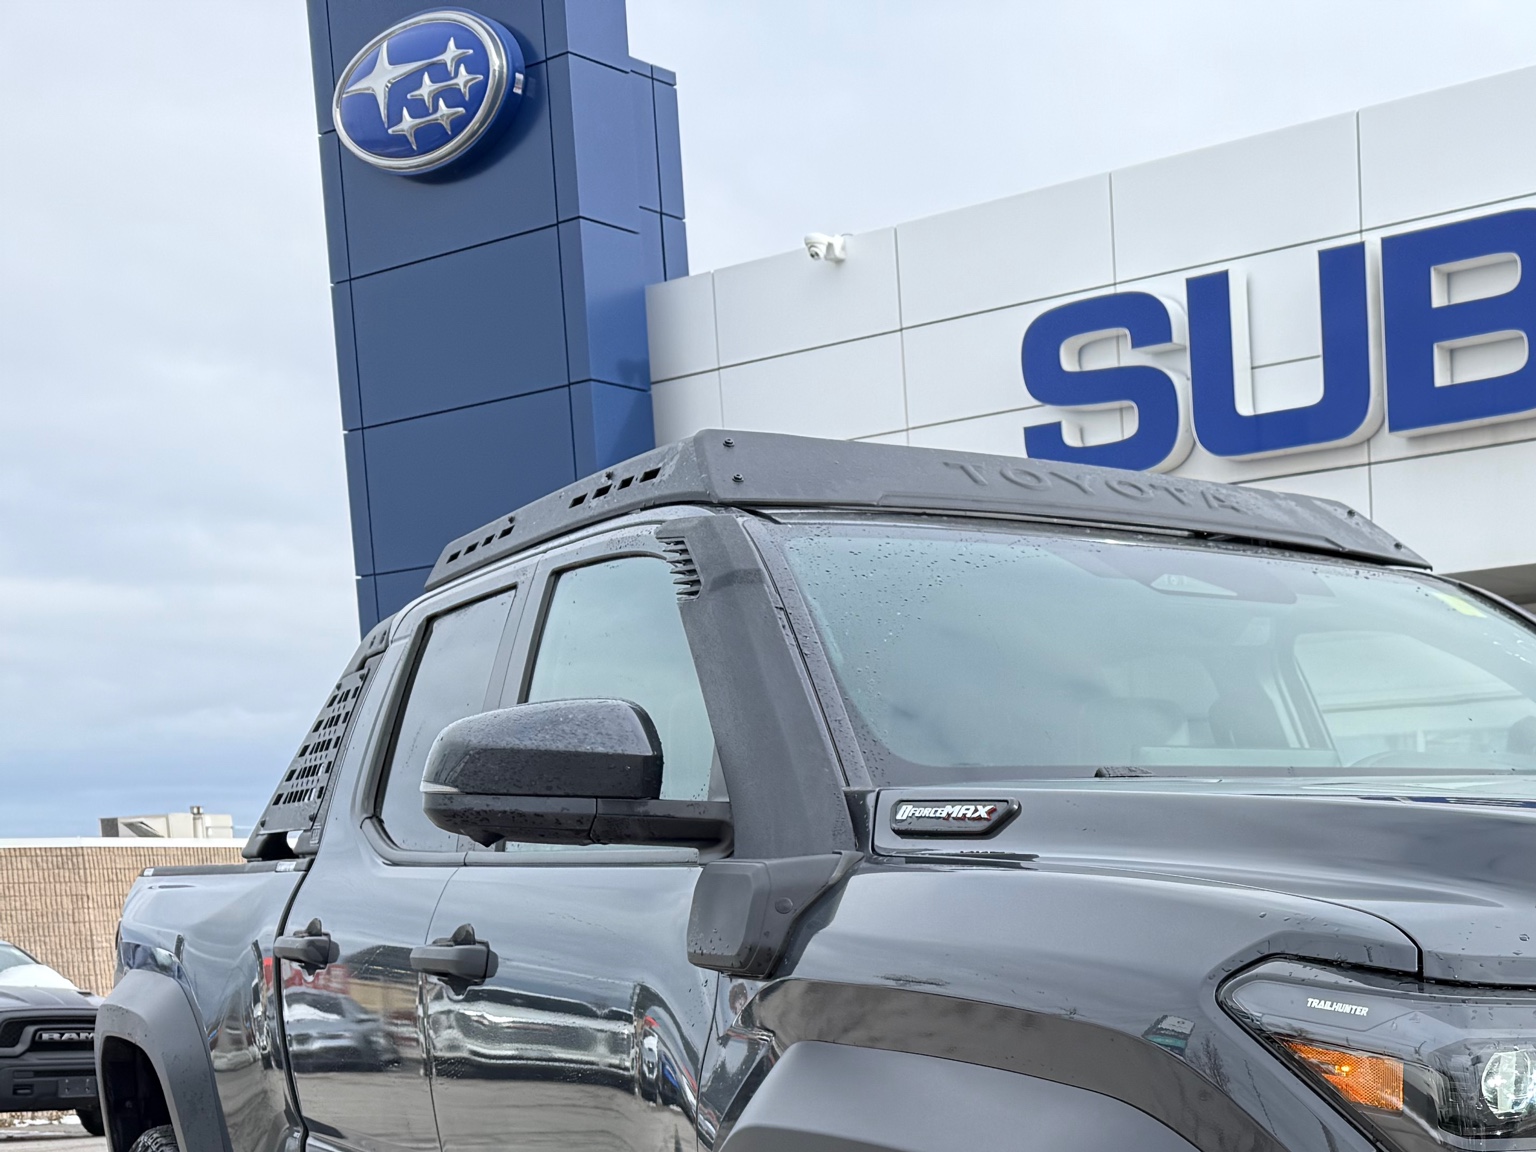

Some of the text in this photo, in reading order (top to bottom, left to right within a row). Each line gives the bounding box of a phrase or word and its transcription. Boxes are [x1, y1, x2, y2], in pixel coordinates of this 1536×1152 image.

[942, 461, 1250, 515] TOYOTA
[1307, 998, 1368, 1016] TRAILHUNTER
[42, 1032, 95, 1041] RAM
